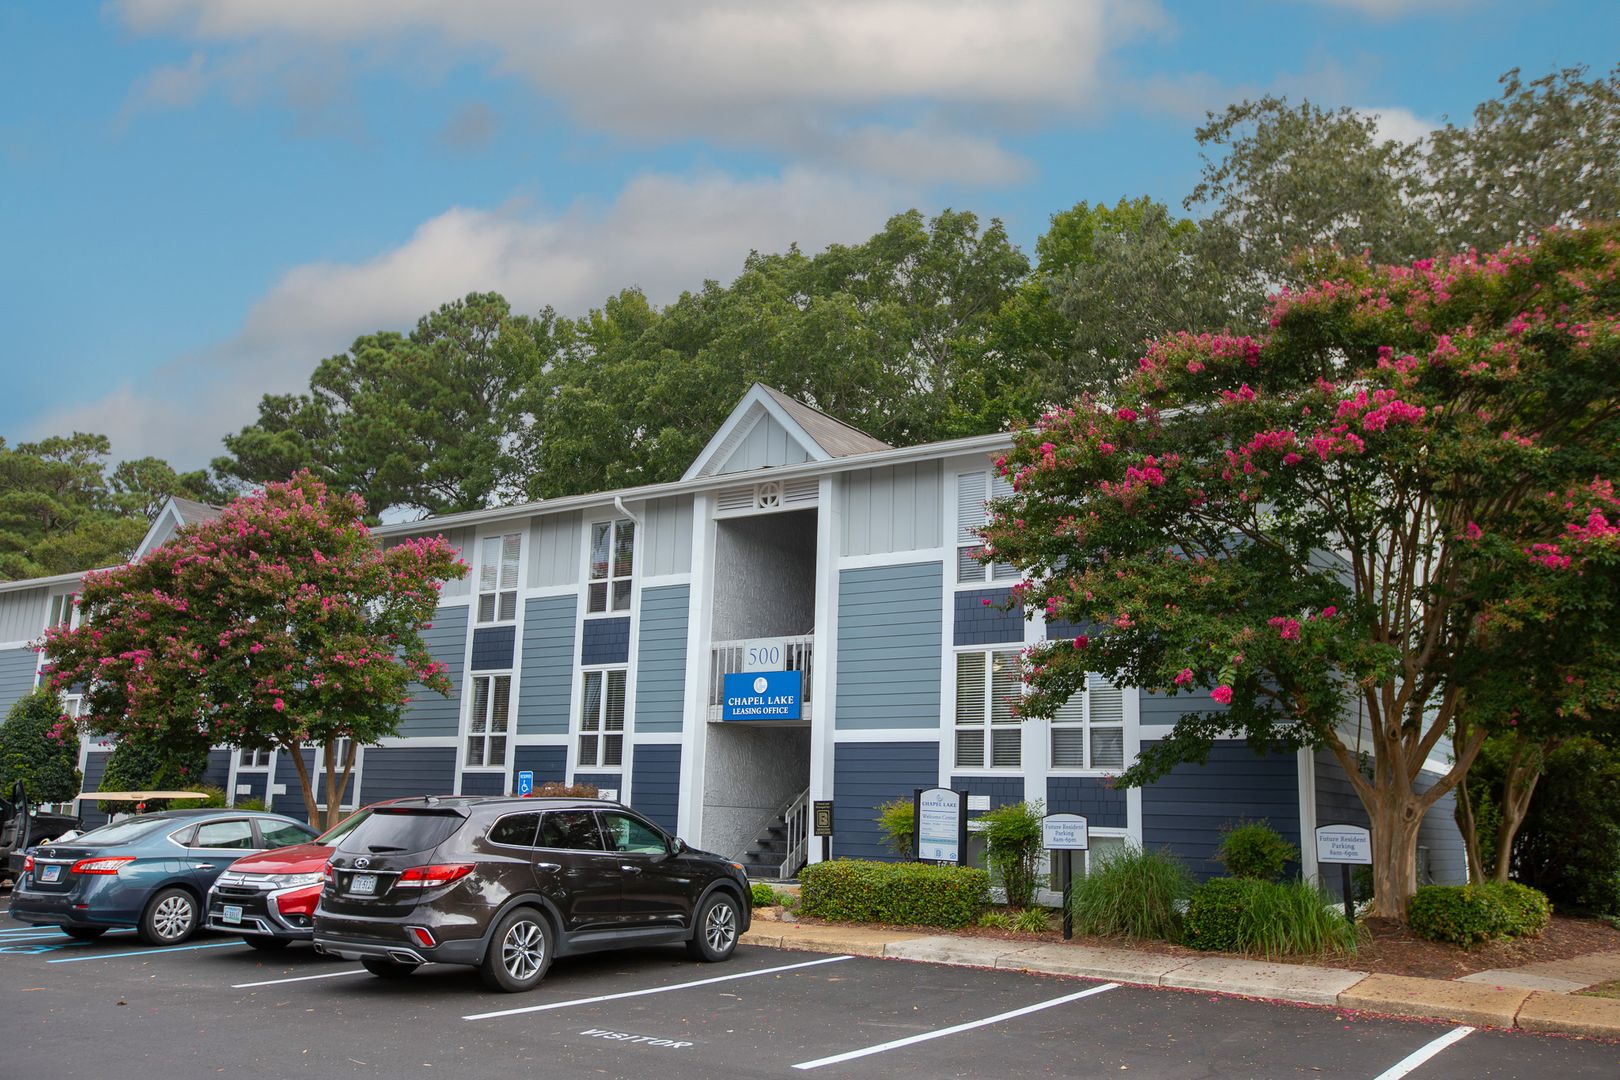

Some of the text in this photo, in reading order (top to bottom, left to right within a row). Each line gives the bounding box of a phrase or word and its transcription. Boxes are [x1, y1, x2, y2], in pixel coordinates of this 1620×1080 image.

[748, 646, 780, 666] 500
[728, 695, 794, 706] CHAPEL LAKE
[732, 706, 789, 715] LEASING OFFICE
[580, 1029, 693, 1048] VISITOR
